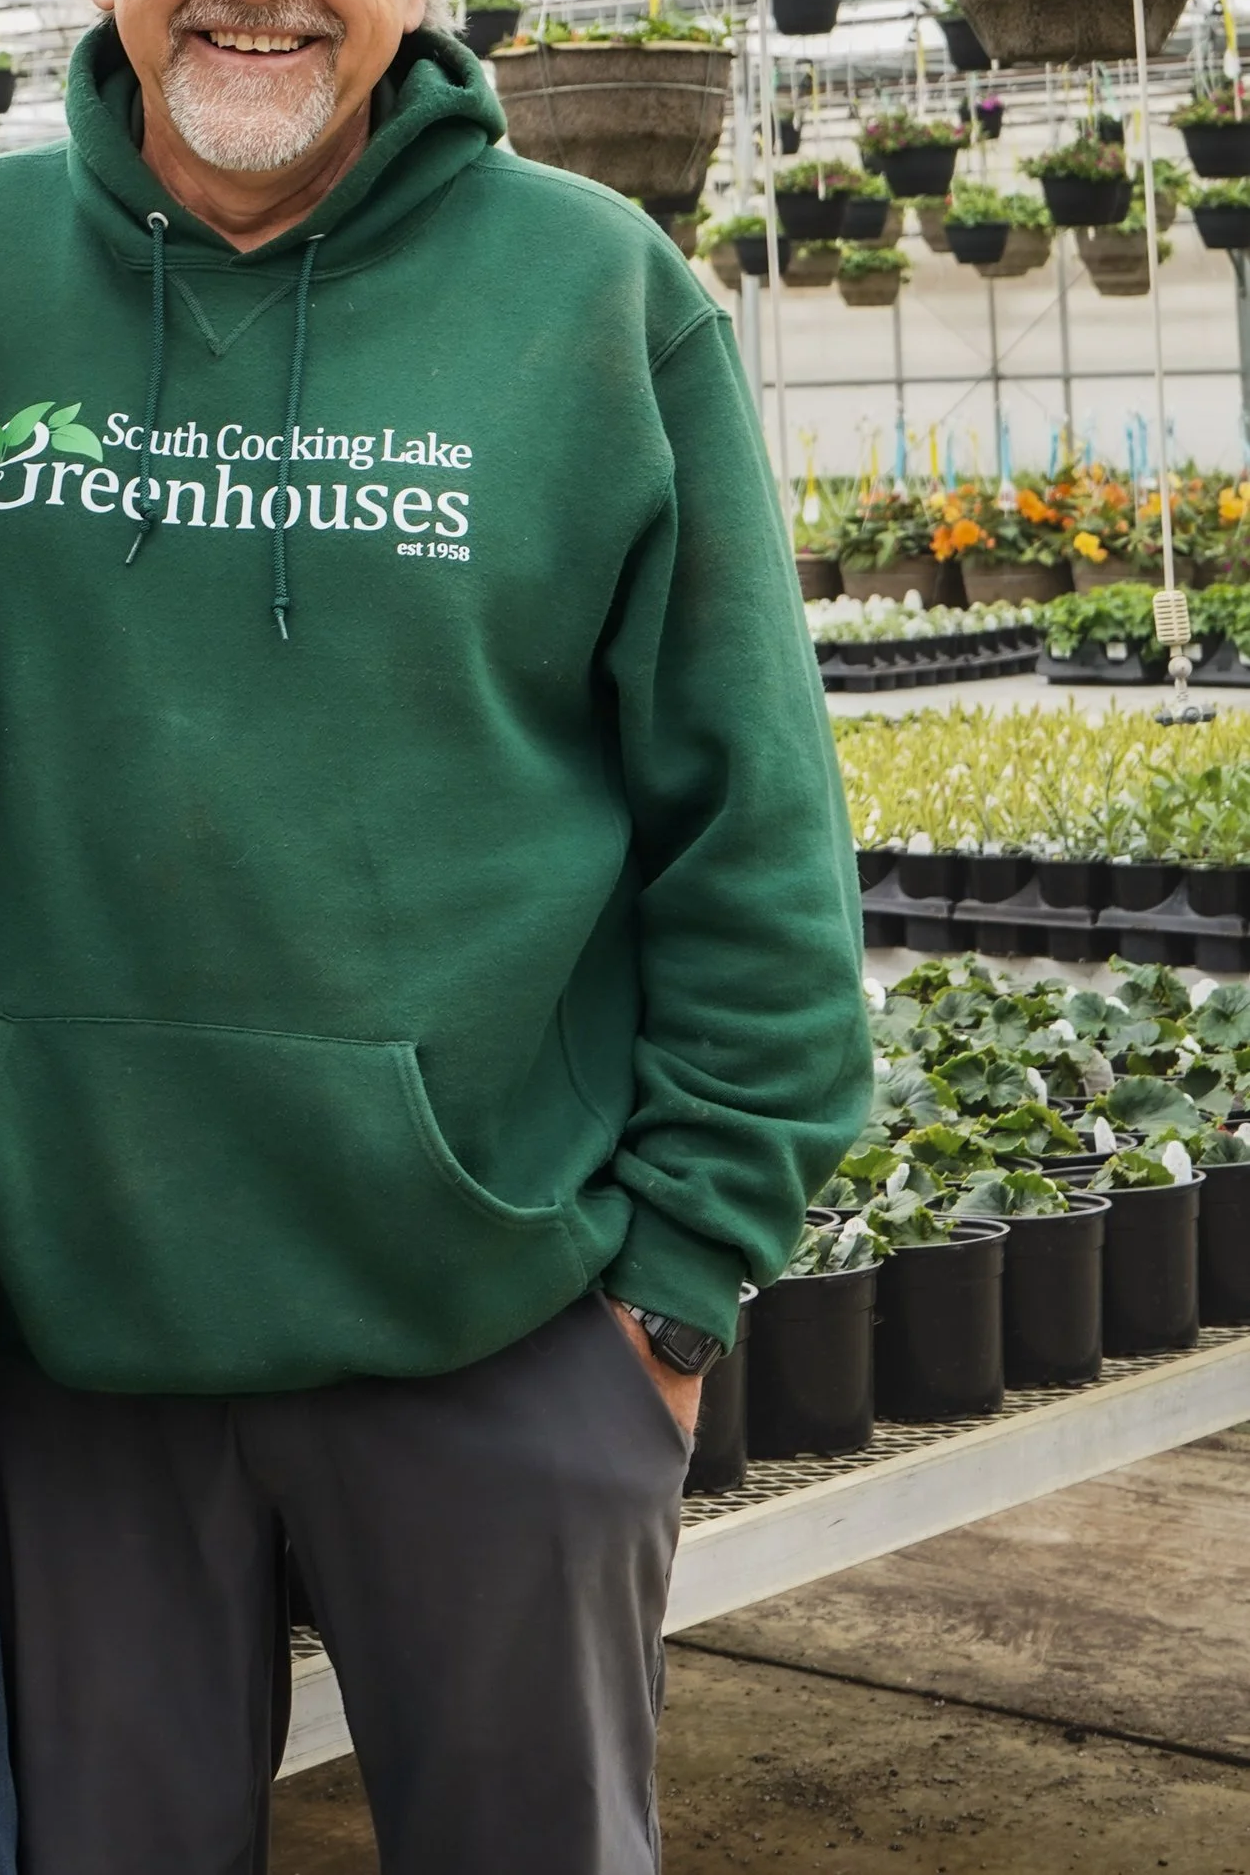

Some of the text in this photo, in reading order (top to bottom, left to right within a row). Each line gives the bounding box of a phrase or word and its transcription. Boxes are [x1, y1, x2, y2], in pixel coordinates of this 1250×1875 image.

[102, 412, 473, 471] South Cooking Lake
[396, 541, 471, 562] est 1958
